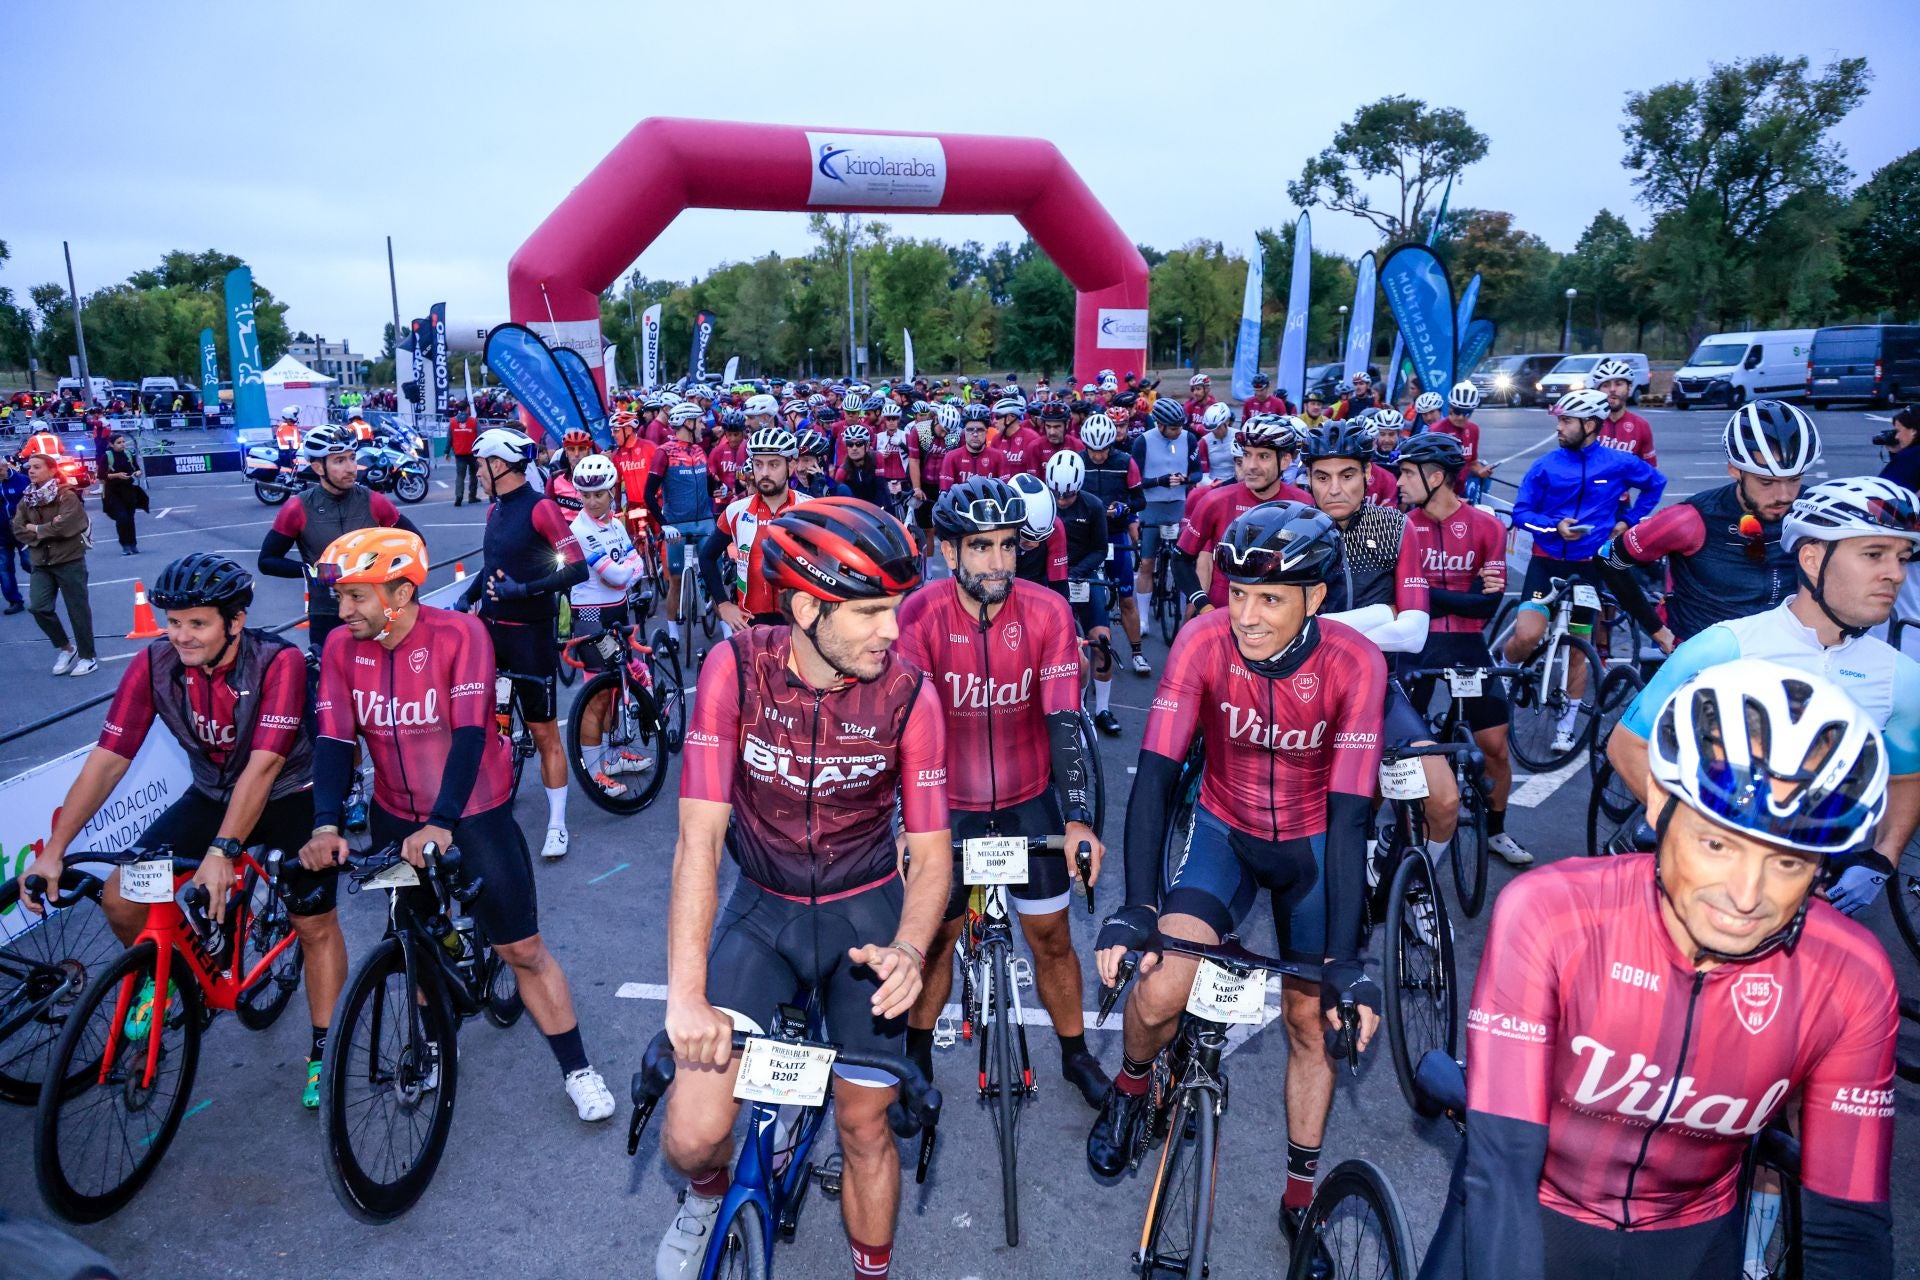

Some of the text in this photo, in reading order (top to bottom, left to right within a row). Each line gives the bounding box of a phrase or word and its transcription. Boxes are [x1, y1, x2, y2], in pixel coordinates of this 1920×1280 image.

[845, 155, 936, 177] kirolaraba
[648, 322, 658, 380] CORREO
[436, 321, 448, 410] EL CORREO
[175, 456, 205, 465] VITORIA
[176, 464, 206, 473] GASTEIZ
[620, 459, 645, 471] Vital
[1421, 547, 1476, 572] Vital
[807, 566, 837, 587] GIRO
[355, 656, 376, 667] GOBIK
[1040, 662, 1079, 676] EUSKADI
[1839, 668, 1866, 680] GSPORT
[944, 668, 1033, 709] Vital
[353, 688, 440, 727] Vital
[262, 714, 301, 725] EUSKAD
[1220, 702, 1327, 750] Vital
[841, 722, 876, 739] Vital
[747, 732, 887, 765] PRUEBA CICLOTURISTA
[918, 768, 947, 781] EUSK
[83, 776, 169, 838] FUNDACIÓN
[986, 859, 1007, 867] B009
[179, 921, 223, 986] TREK
[1610, 961, 1661, 993] GOBIK
[1212, 982, 1245, 992] KARLOS
[1745, 981, 1771, 997] 1955
[1215, 994, 1239, 1003] B265
[1468, 1009, 1490, 1024] raba
[769, 1059, 806, 1070] EKAITZ
[771, 1071, 799, 1082] B202
[1570, 1034, 1791, 1136] Vital
[1836, 1088, 1895, 1105] EUSK
[1831, 1101, 1878, 1117] BASQUE
